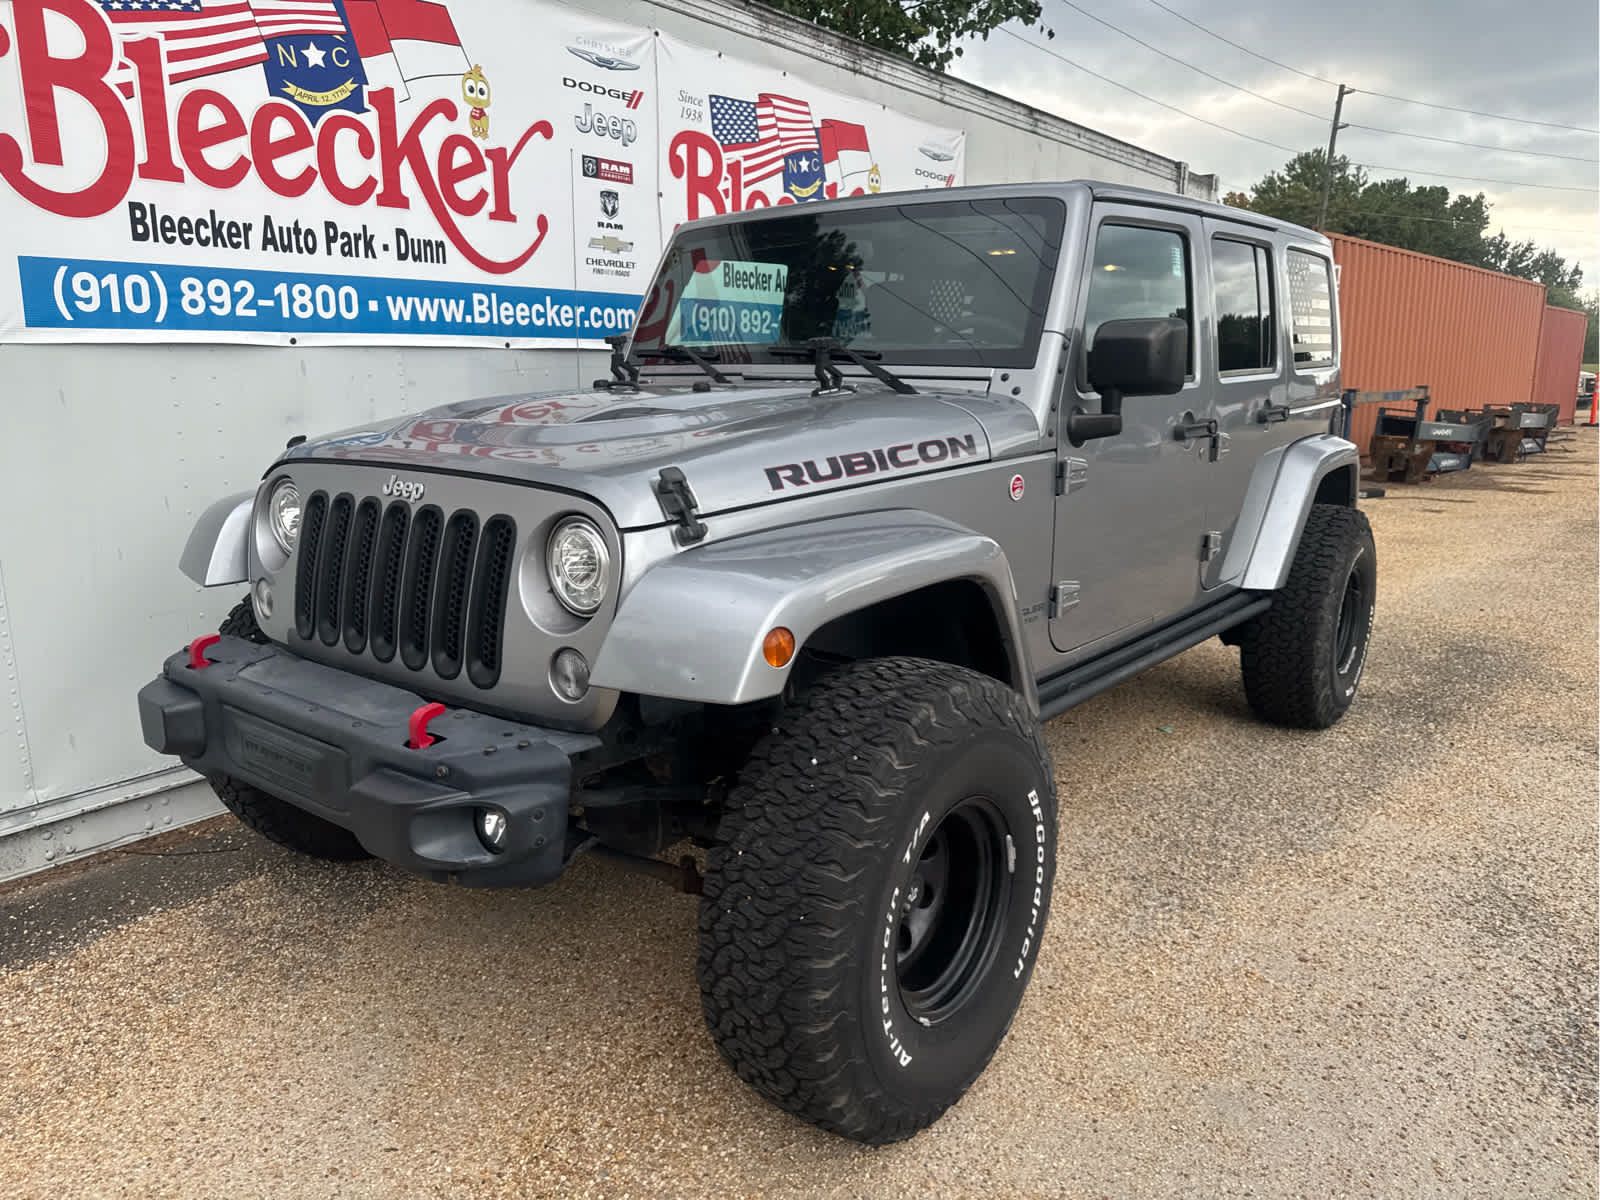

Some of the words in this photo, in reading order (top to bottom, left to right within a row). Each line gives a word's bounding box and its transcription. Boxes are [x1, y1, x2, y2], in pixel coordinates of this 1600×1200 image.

[277, 43, 297, 68] N
[332, 47, 350, 68] C
[576, 36, 632, 57] CHRYSLER
[562, 77, 633, 101] DODGE
[678, 89, 704, 107] Since
[574, 103, 637, 147] Jeep
[680, 107, 703, 122] 1938
[0, 0, 553, 274] Bleecker
[600, 162, 630, 174] RAM
[128, 202, 253, 250] Bleecker
[262, 215, 317, 255] Auto
[325, 221, 377, 259] Park
[396, 228, 447, 265] Dunn
[597, 221, 624, 230] RAM
[585, 257, 637, 270] CHEVROLET
[723, 262, 772, 292] Bleecker
[54, 265, 168, 323] (910)
[181, 278, 359, 319] 892-1800
[387, 292, 636, 329] www.Bleecker.com
[691, 303, 737, 337] (910)
[765, 435, 976, 490] RUBICON
[383, 474, 425, 502] Jeep
[880, 887, 913, 1067] All-Terrain
